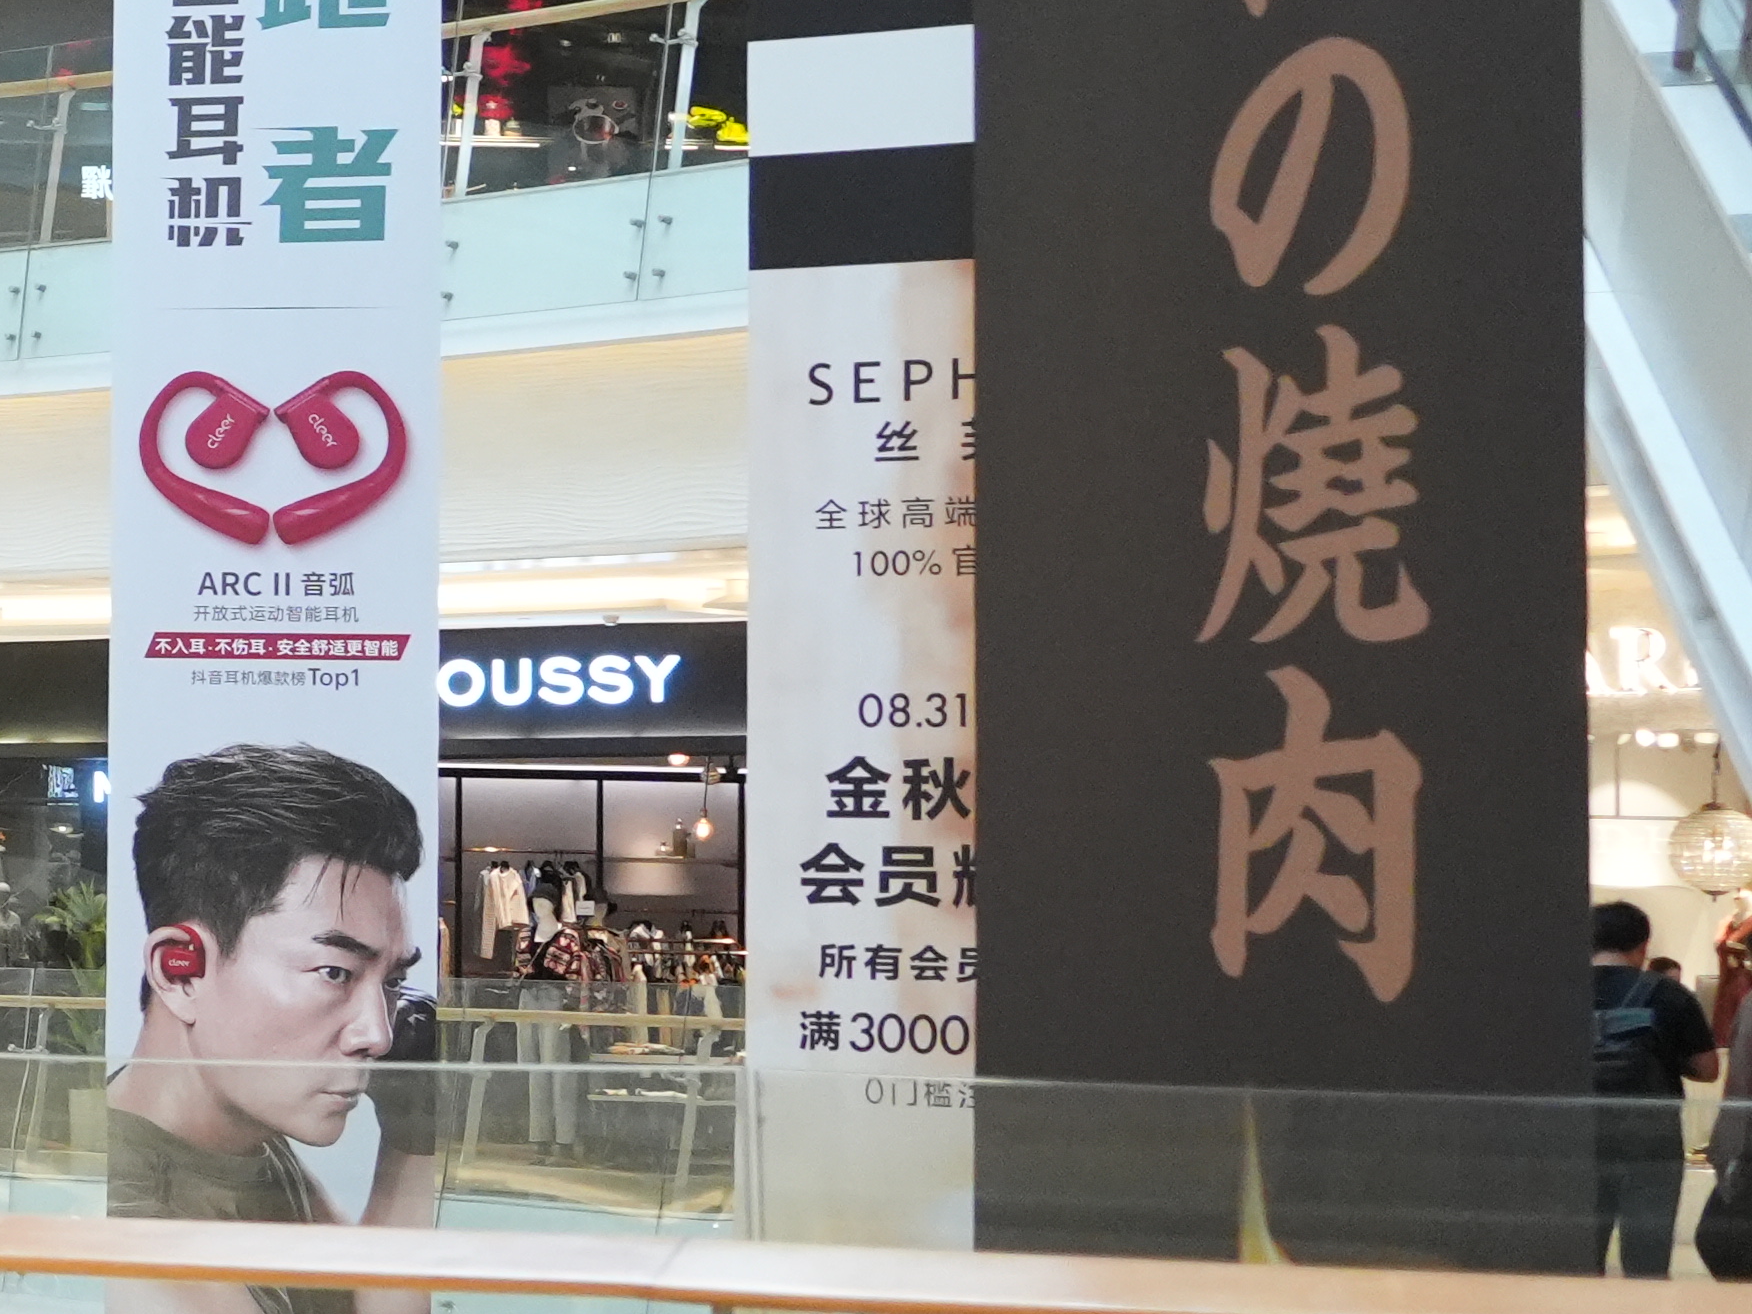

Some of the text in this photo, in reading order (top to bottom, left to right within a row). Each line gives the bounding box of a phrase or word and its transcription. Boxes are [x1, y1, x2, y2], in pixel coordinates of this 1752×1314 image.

[197, 572, 262, 596] ARC
[300, 571, 355, 597] 音弧
[193, 605, 359, 623] 开放式运动智能耳机
[858, 693, 968, 728] 08.31
[825, 755, 972, 821] 金秋
